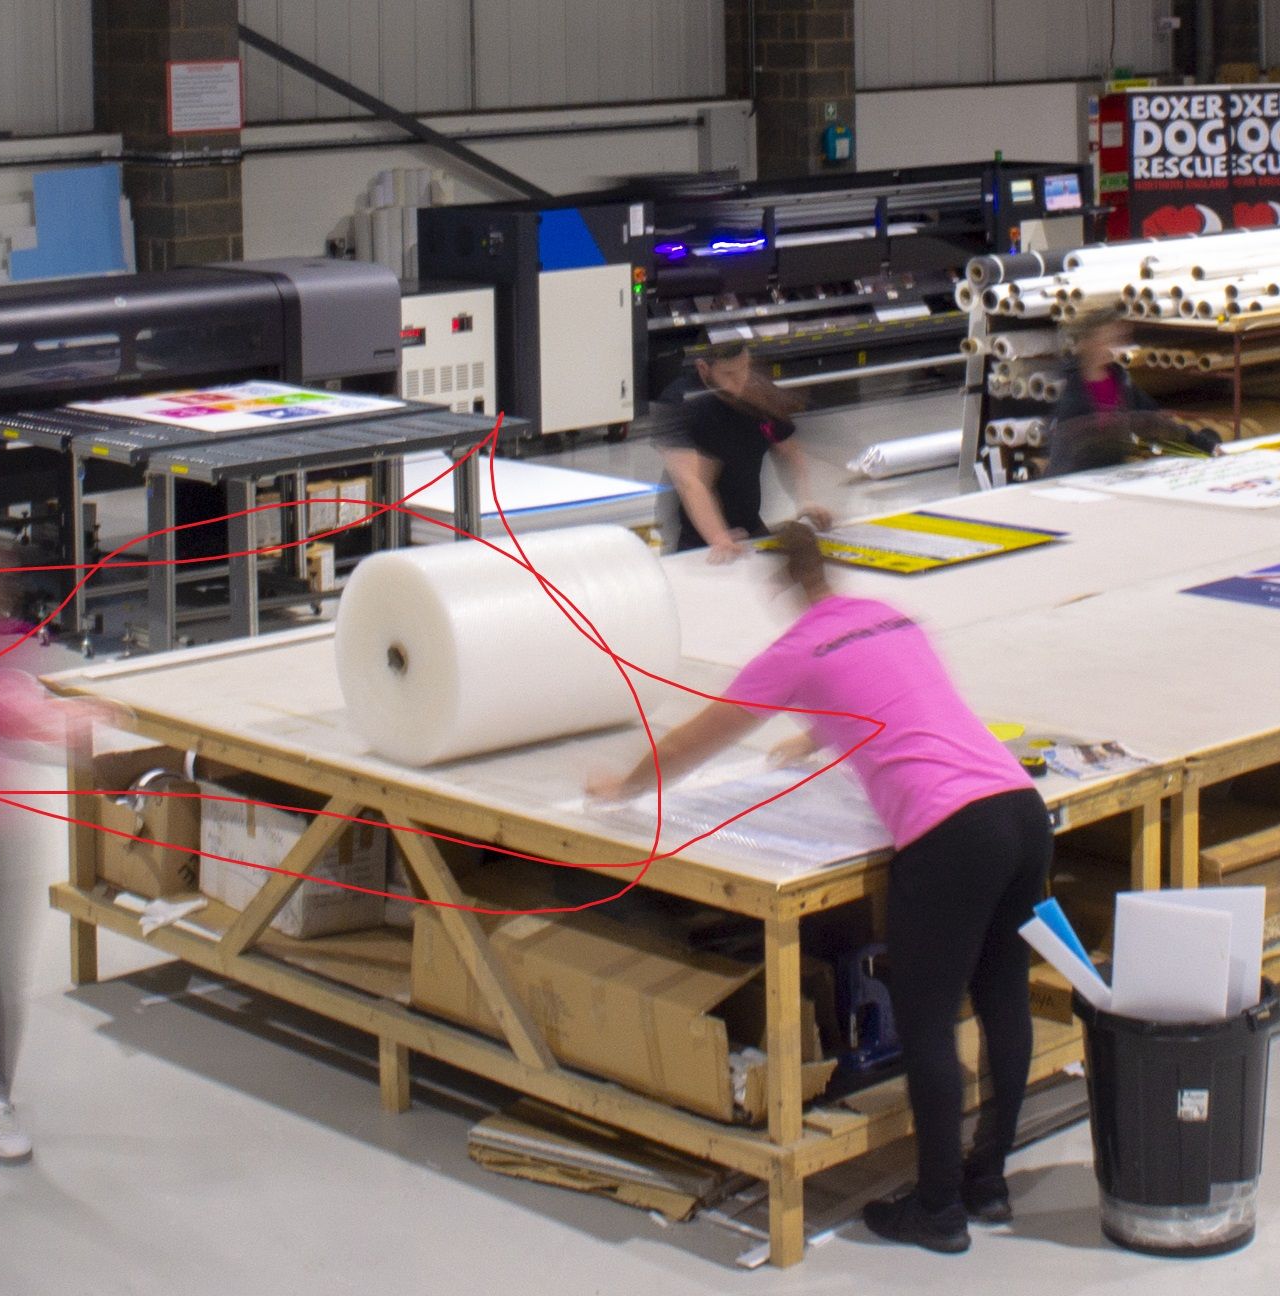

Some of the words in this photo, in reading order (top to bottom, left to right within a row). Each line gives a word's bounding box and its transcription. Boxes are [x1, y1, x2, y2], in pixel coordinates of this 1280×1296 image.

[1132, 95, 1225, 120] BOXER
[1133, 118, 1227, 158] DOG
[1133, 155, 1228, 180] RESCUE
